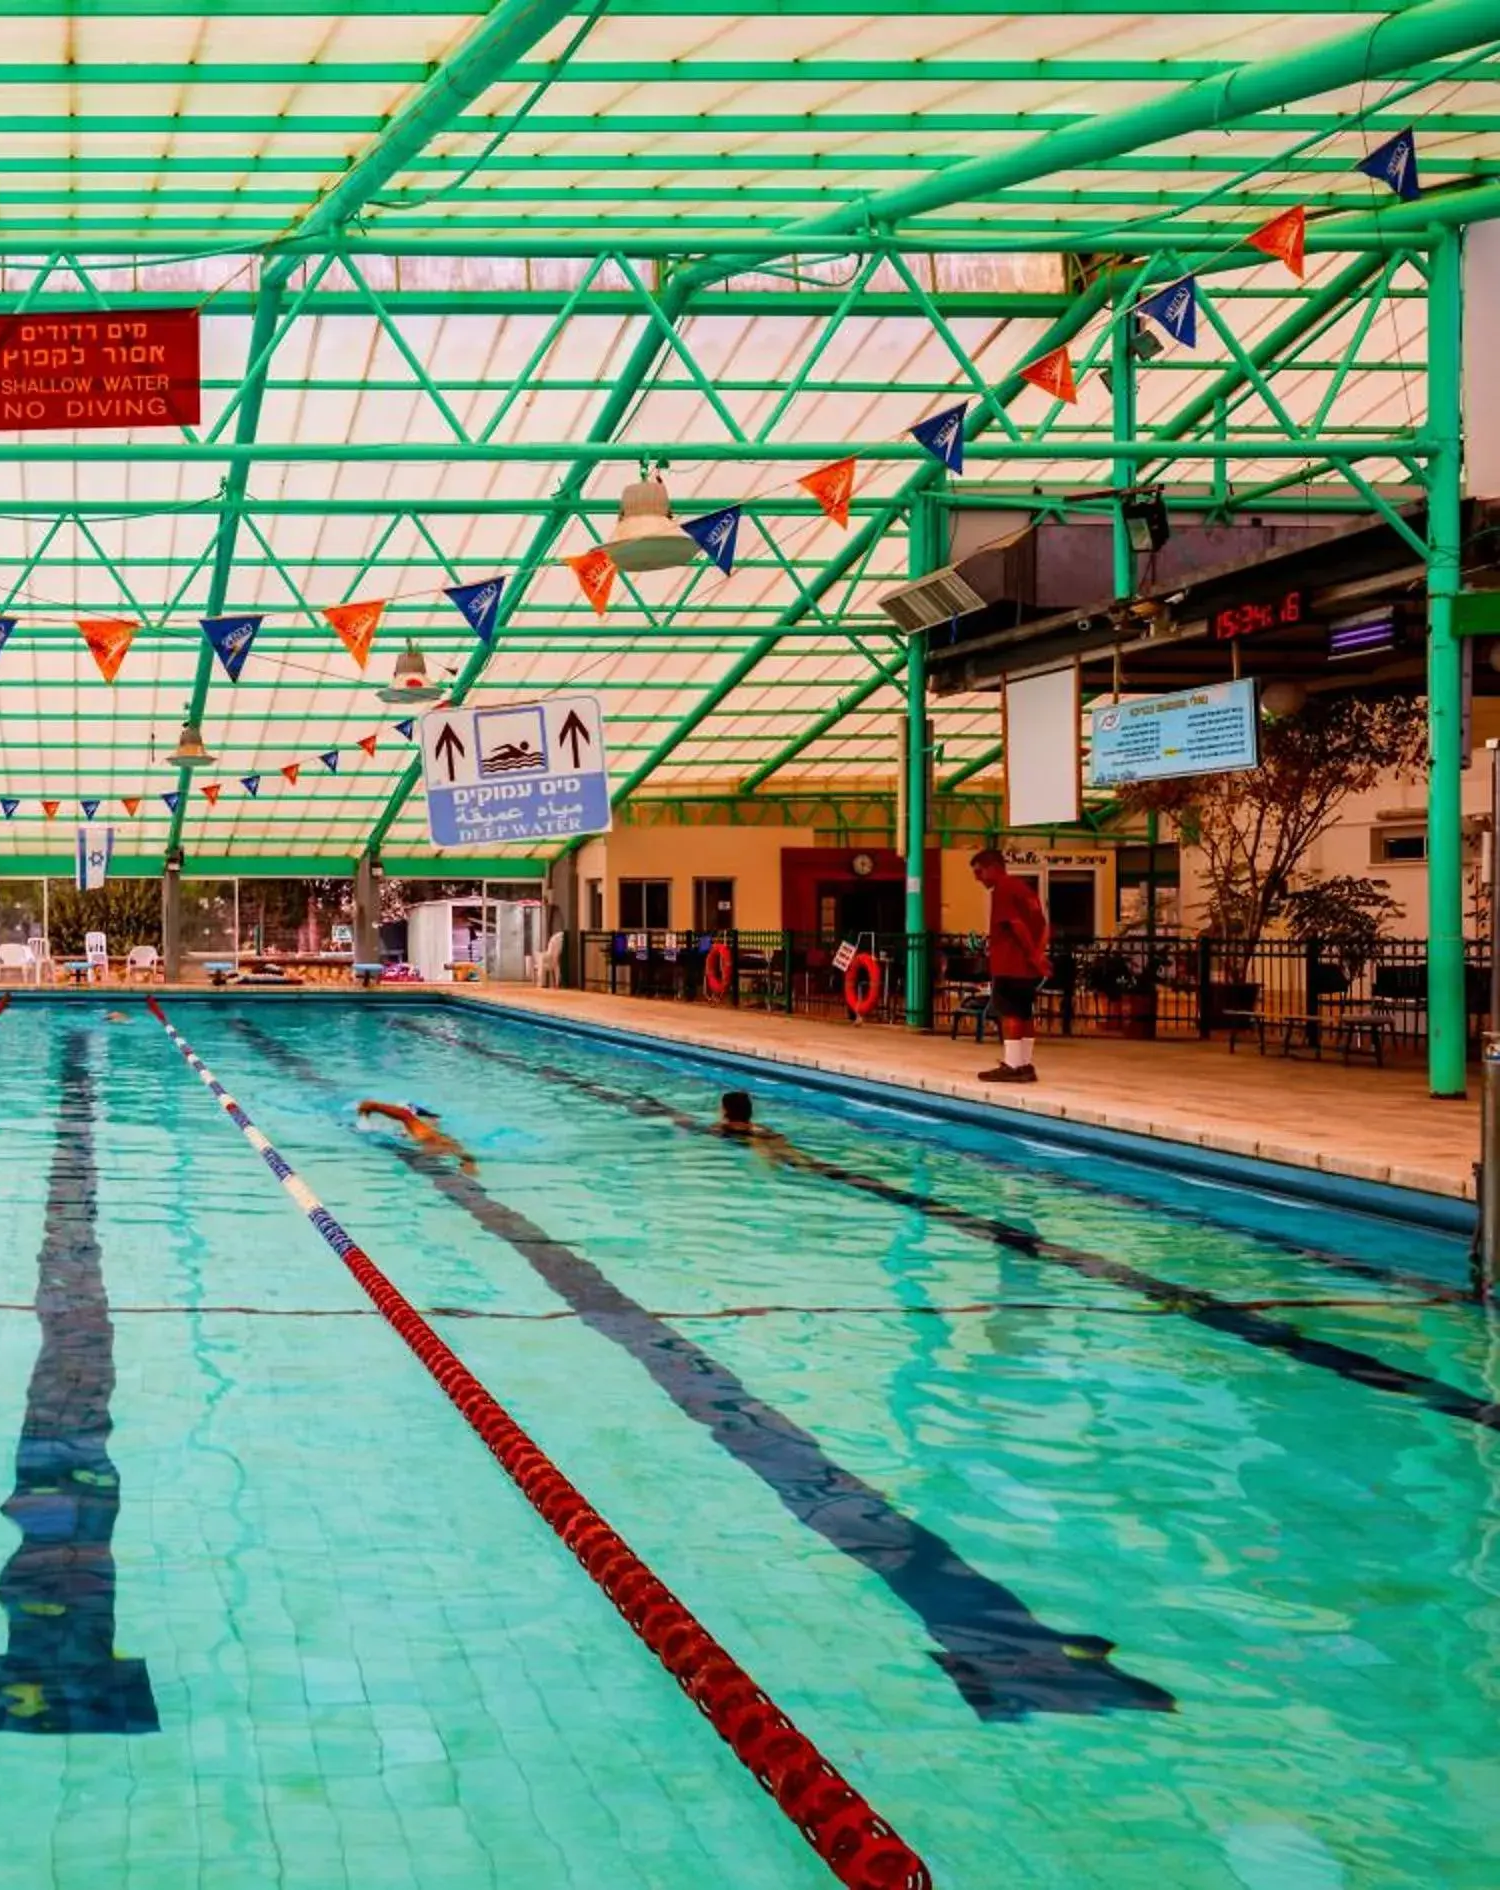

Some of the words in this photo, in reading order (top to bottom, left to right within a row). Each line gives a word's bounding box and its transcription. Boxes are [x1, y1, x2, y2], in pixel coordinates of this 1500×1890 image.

[21, 324, 97, 341] רדודים
[107, 323, 147, 339] מים
[3, 345, 85, 369] לקפוץ
[102, 345, 165, 364] אסור
[1, 376, 93, 395] SHALLOW
[103, 374, 169, 392] WATER
[4, 401, 45, 420] NO
[67, 397, 167, 418] DIVING
[453, 784, 532, 807] עמוקים
[539, 778, 581, 796] מים
[455, 806, 524, 827] عميقة
[537, 801, 583, 819] مياه
[458, 826, 509, 842] DEEP
[514, 818, 582, 836] WATER
